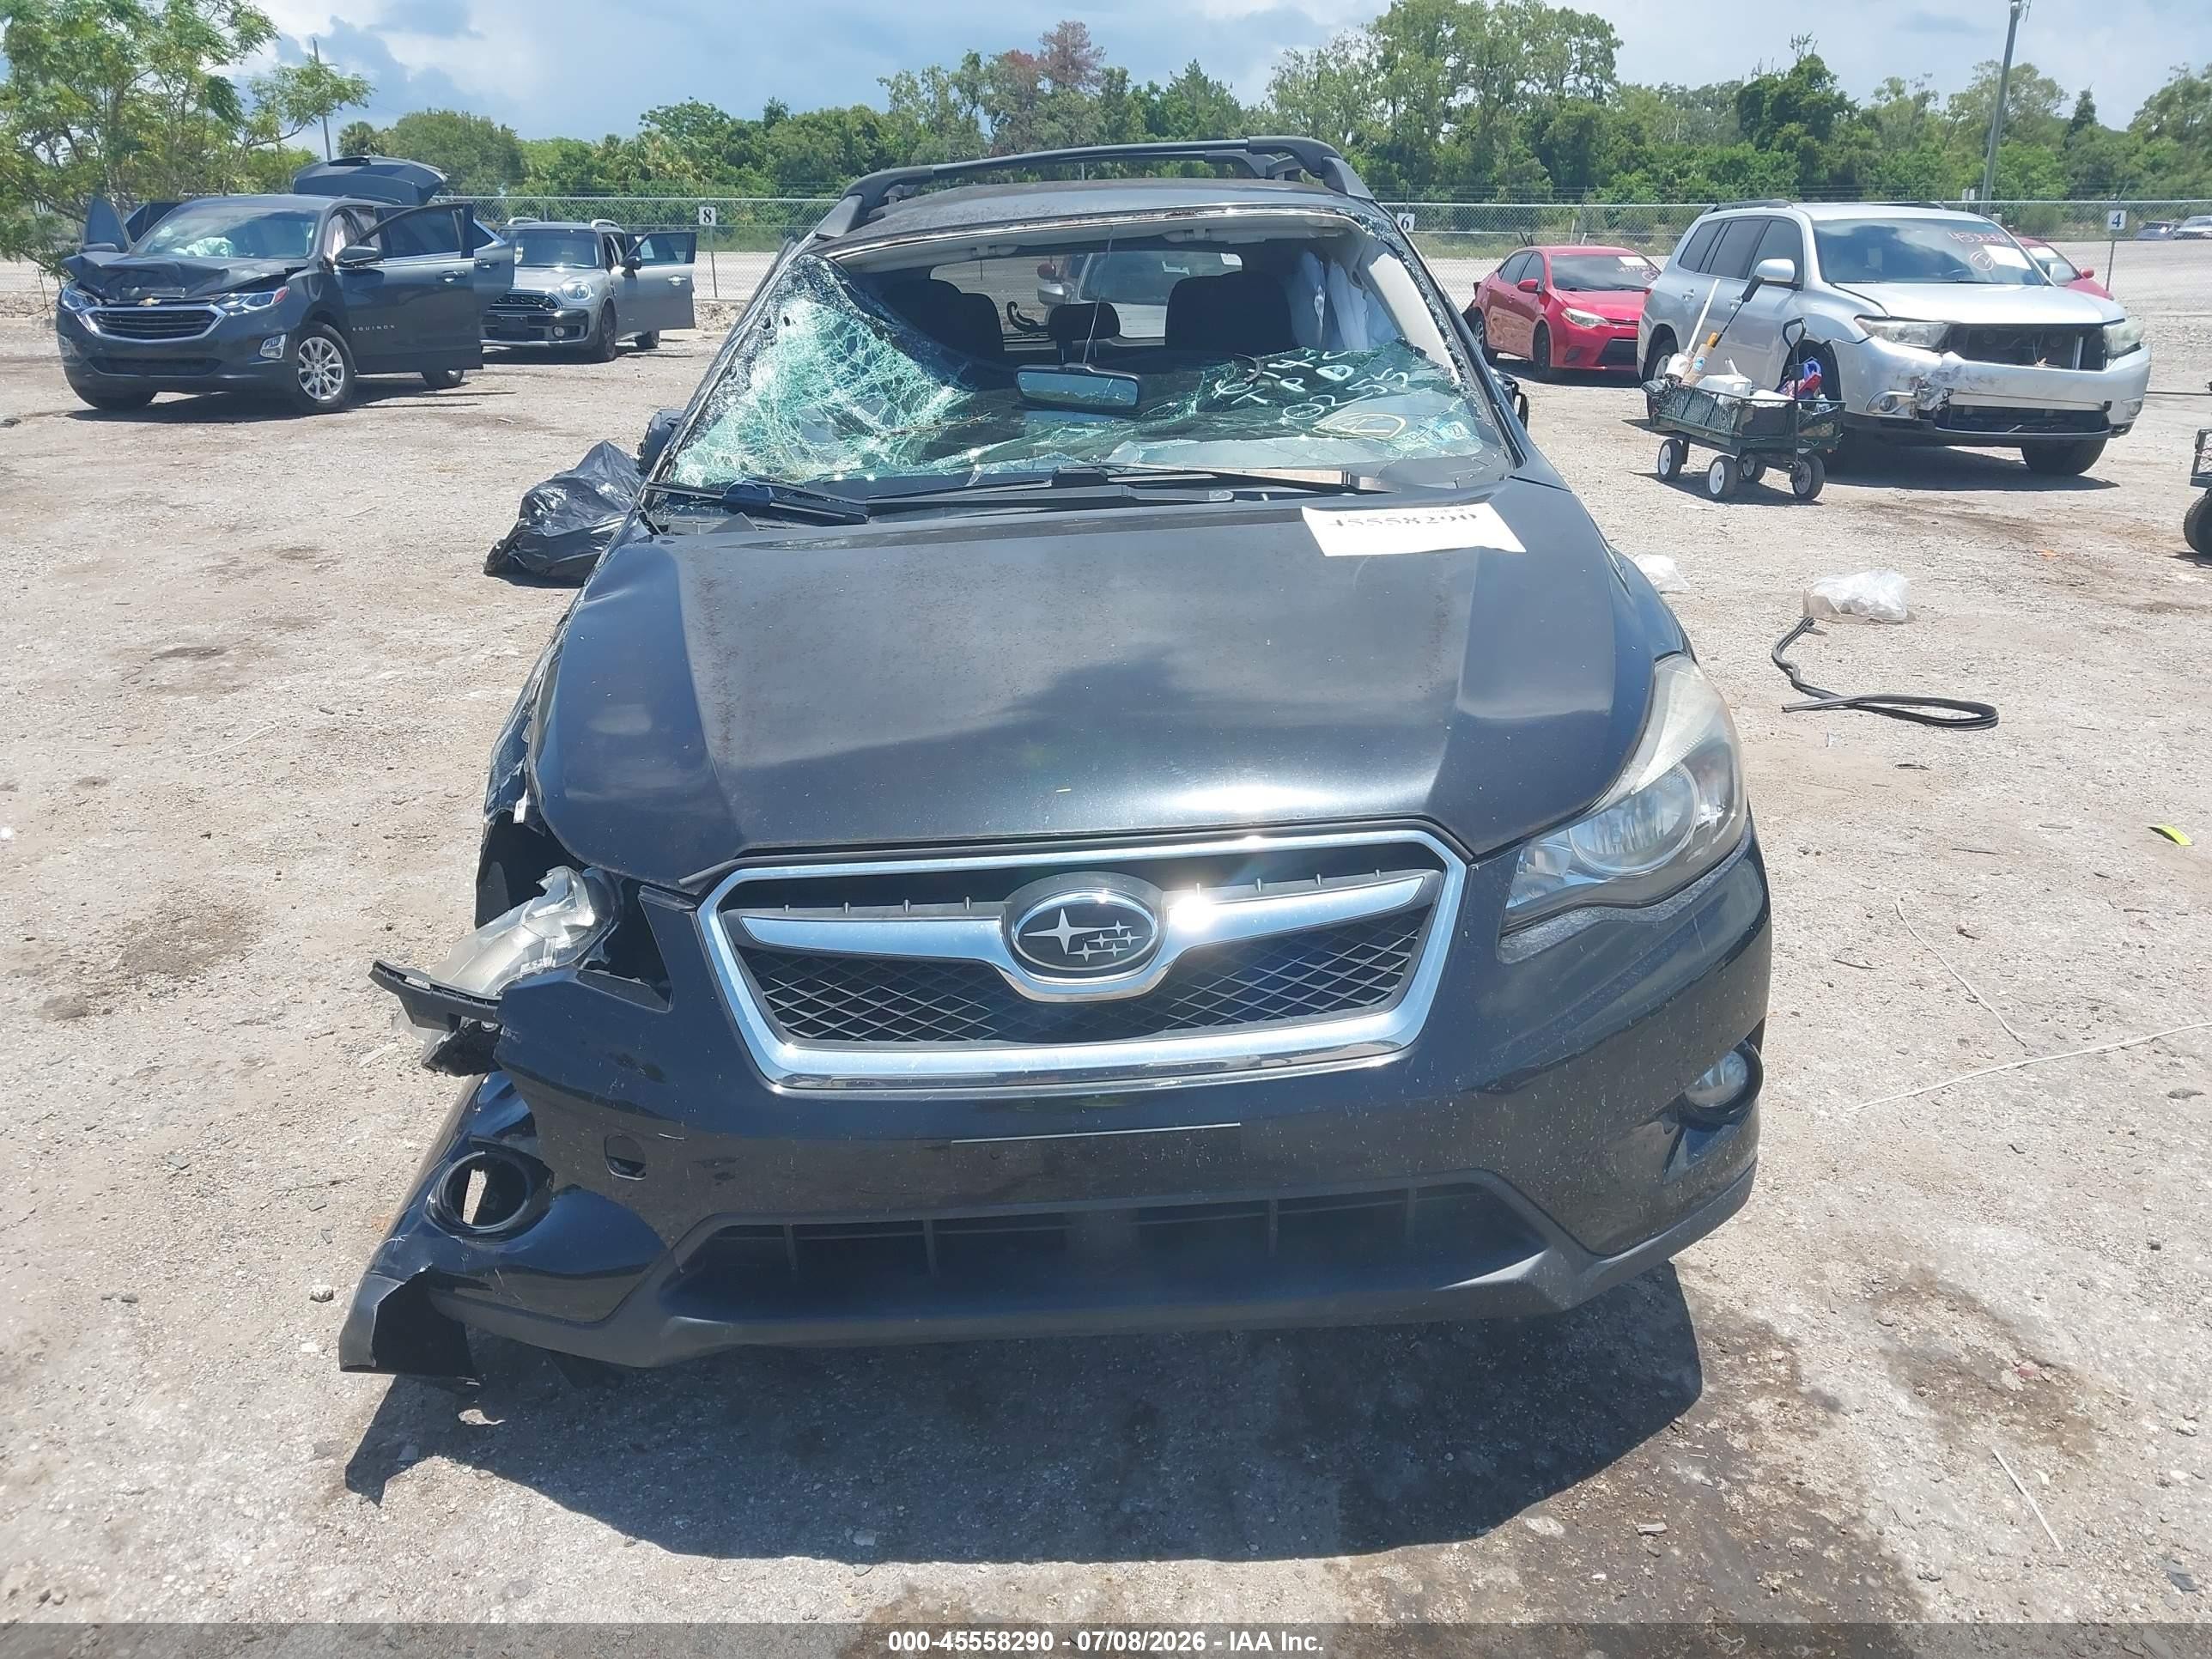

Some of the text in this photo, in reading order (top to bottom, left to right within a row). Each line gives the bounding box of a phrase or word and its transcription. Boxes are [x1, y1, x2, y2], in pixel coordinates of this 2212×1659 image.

[703, 209, 712, 223] 8
[1401, 215, 1410, 230] 6
[2112, 213, 2122, 228] 4
